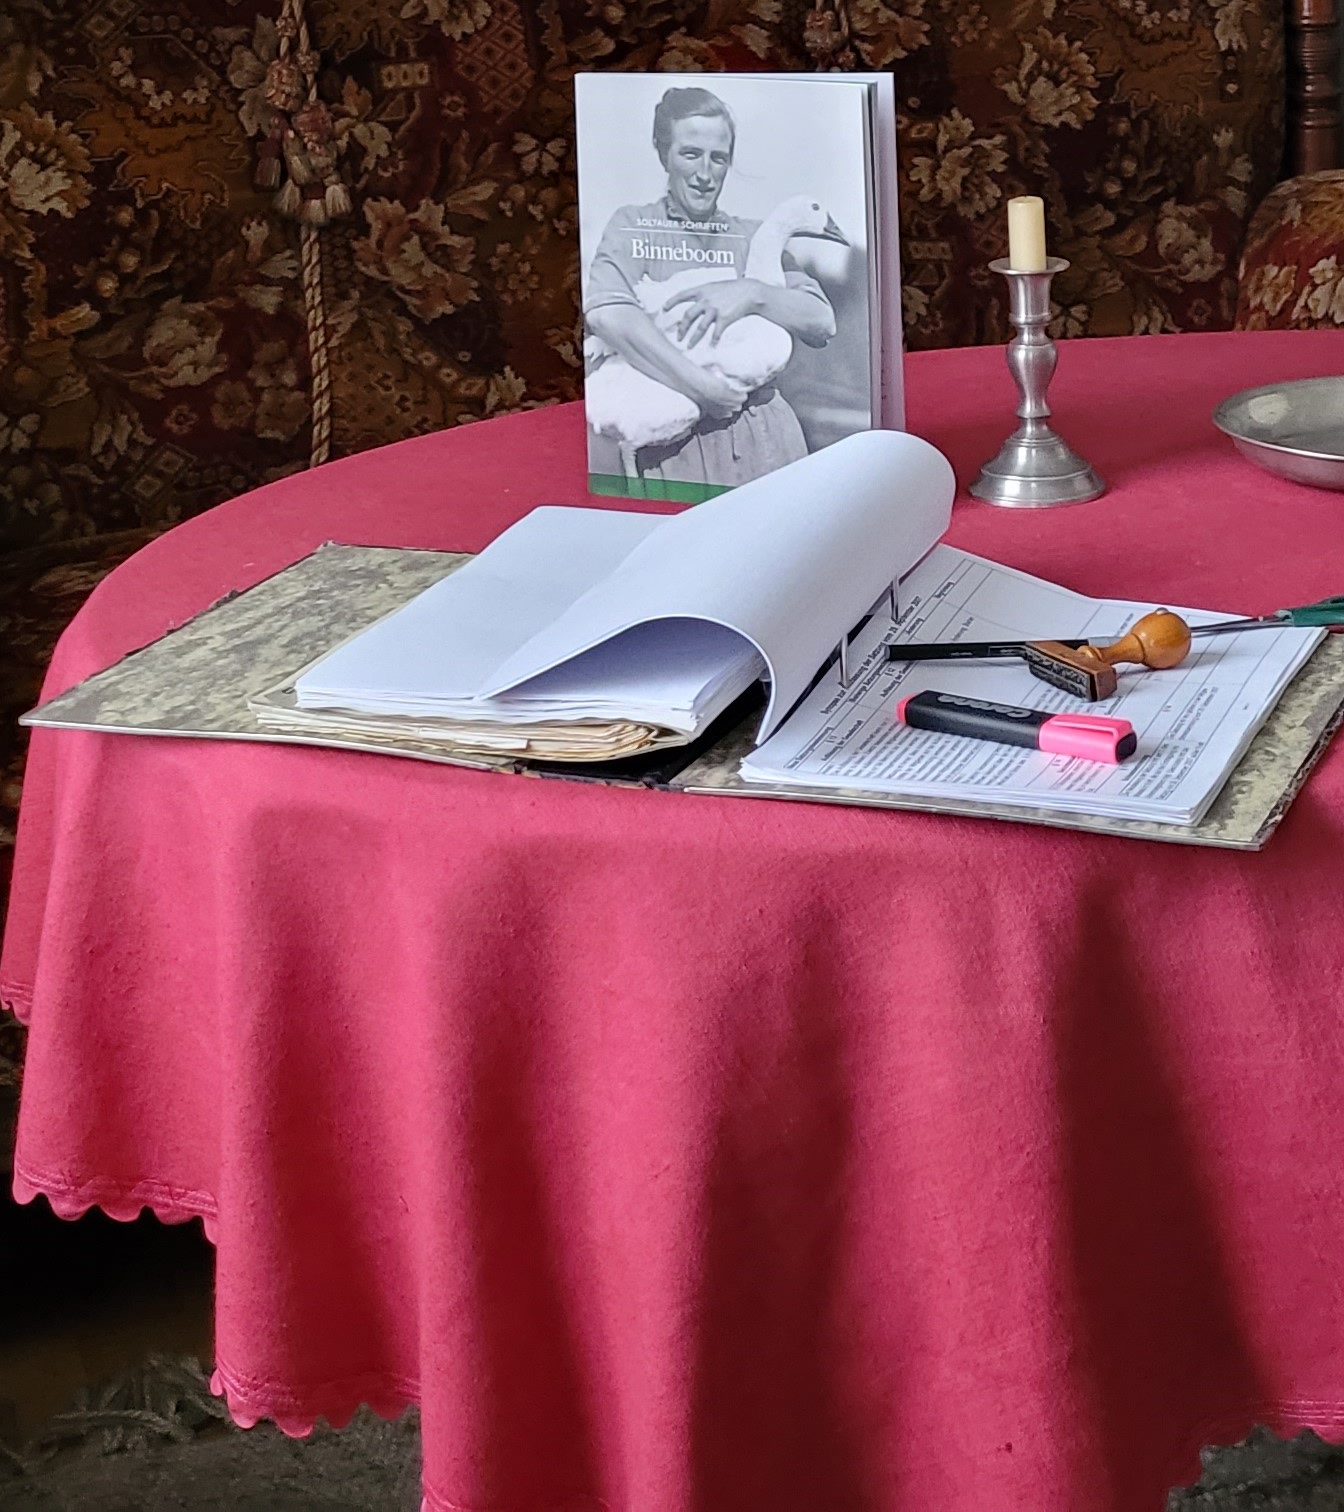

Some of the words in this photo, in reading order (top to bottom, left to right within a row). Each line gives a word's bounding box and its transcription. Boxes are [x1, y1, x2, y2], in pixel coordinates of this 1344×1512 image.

[636, 217, 679, 229] SOLTAUER
[681, 219, 730, 233] SCHRIFTEN
[631, 238, 736, 265] Binneboom
